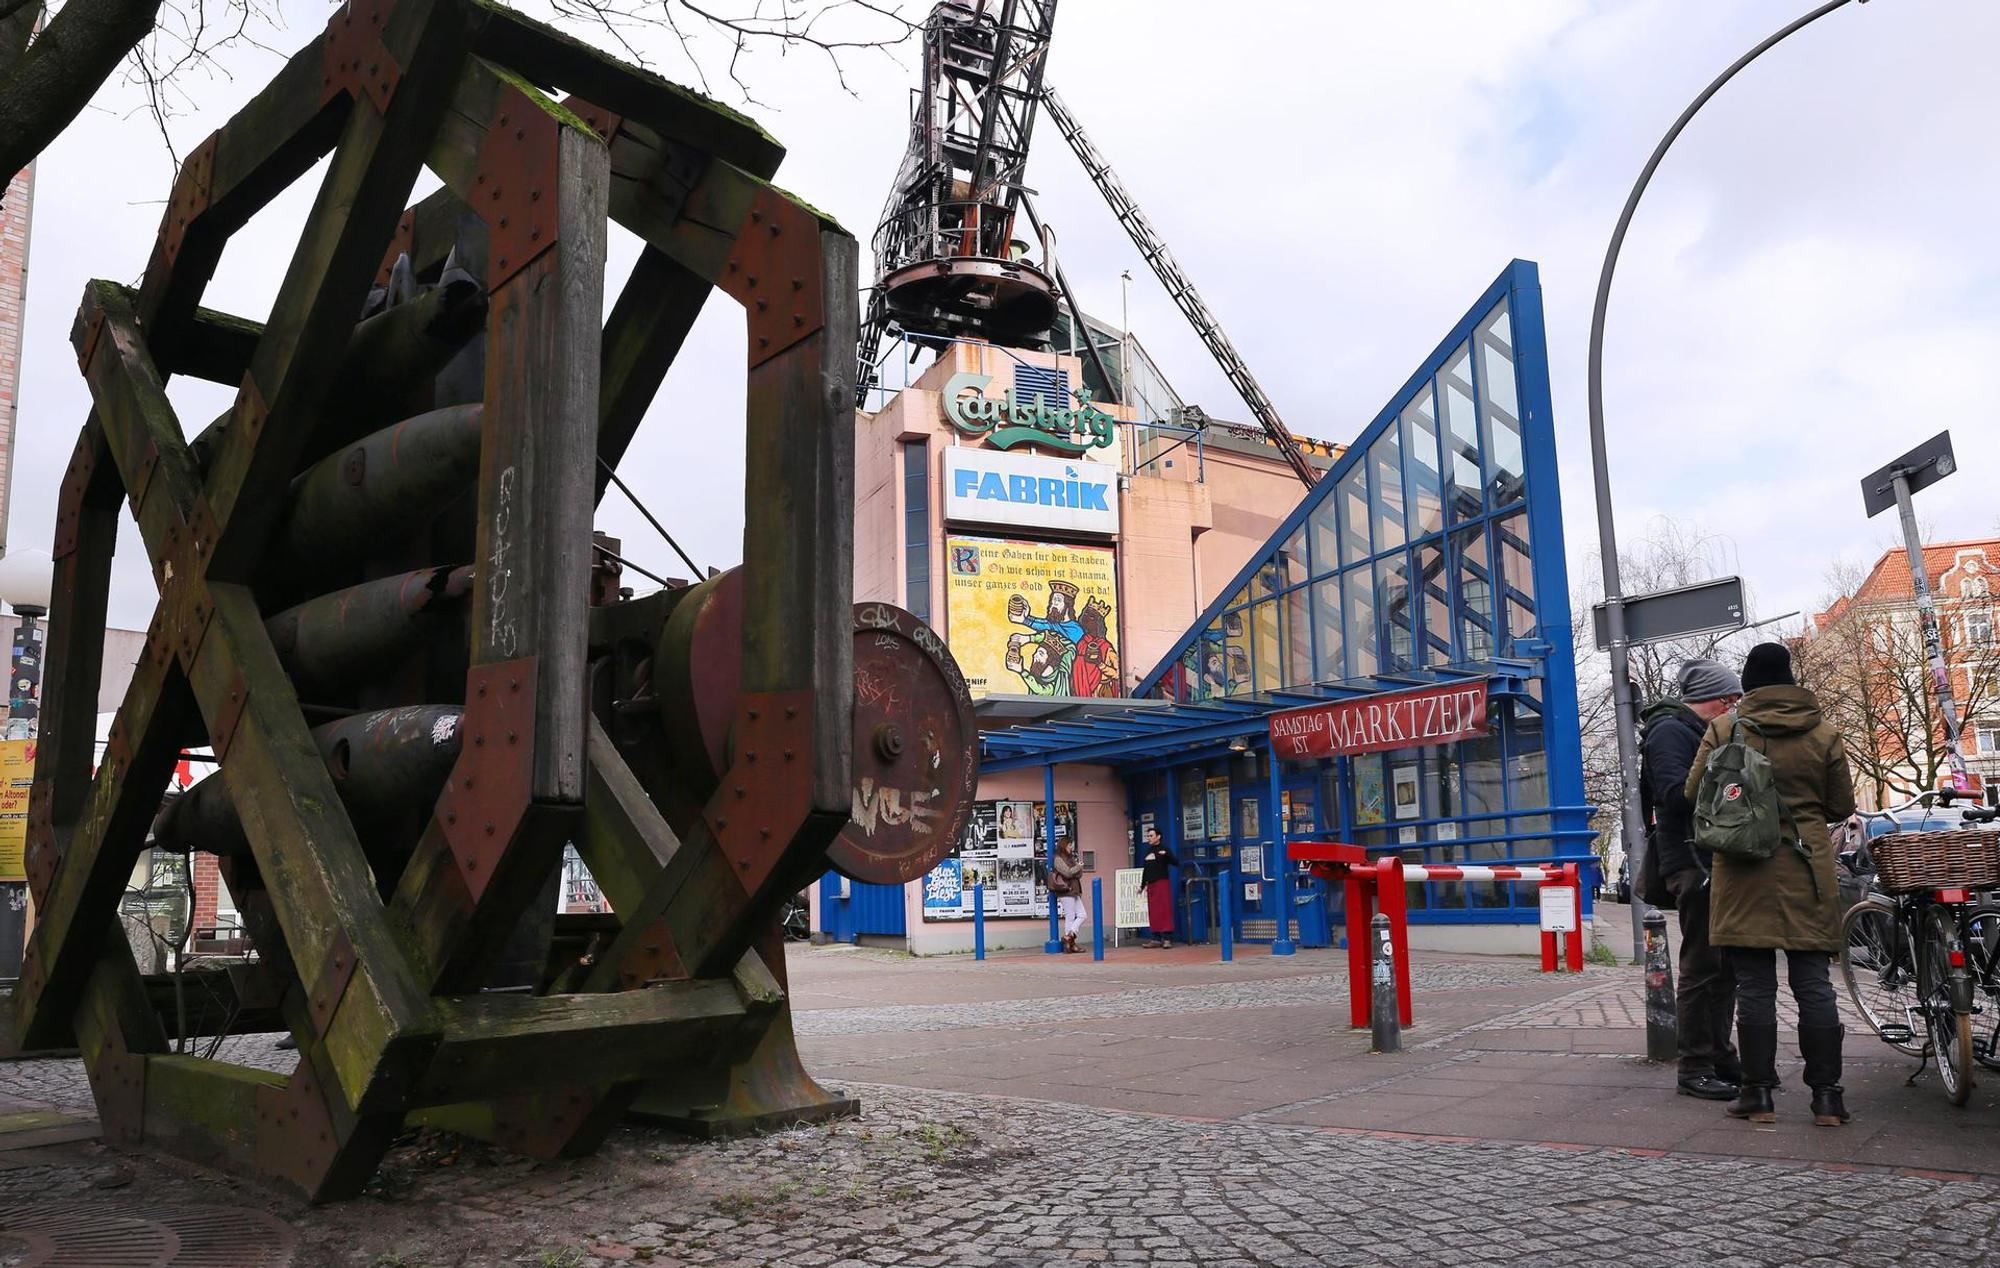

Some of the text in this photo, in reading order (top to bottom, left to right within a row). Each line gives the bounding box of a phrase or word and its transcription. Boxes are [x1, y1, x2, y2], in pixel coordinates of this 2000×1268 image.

[943, 373, 1113, 448] Carlsberg
[954, 466, 1109, 511] FABRIK
[1002, 549, 1033, 561] Gaben
[1052, 552, 1068, 563] den
[988, 562, 1004, 574] Oh
[1007, 564, 1023, 575] wie
[1054, 567, 1066, 578] ist
[955, 578, 1110, 596] unser ganzes Gold ist da!
[1274, 713, 1323, 737] SAMSTAG
[1326, 689, 1482, 750] MARKTZEIT
[1292, 736, 1309, 754] IST
